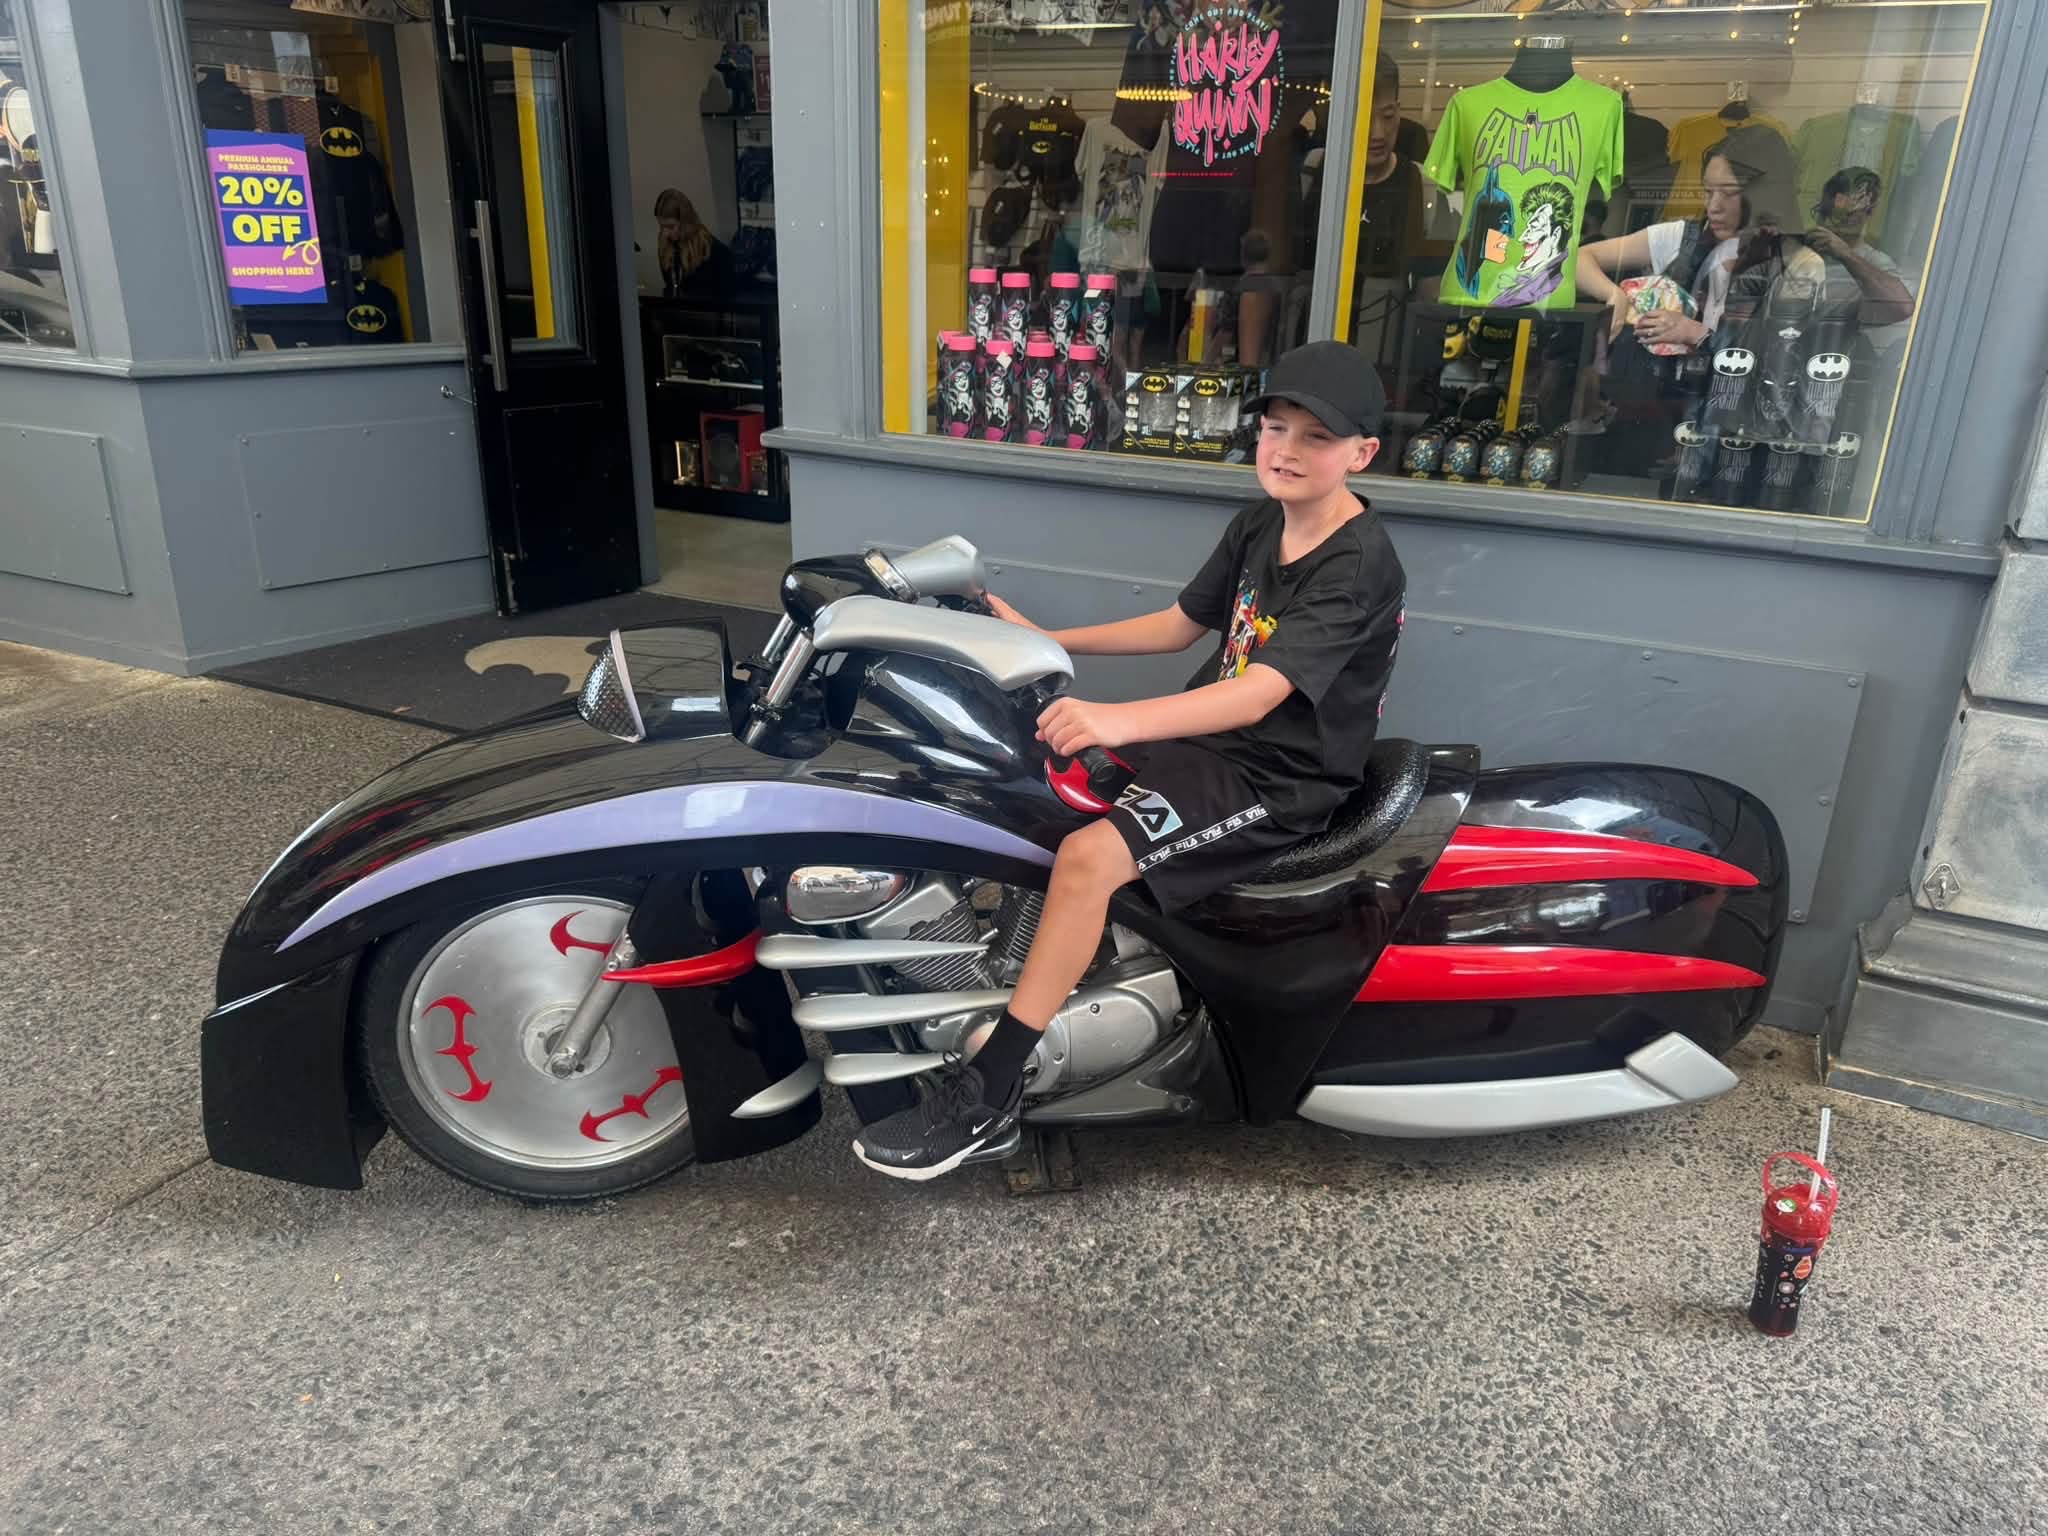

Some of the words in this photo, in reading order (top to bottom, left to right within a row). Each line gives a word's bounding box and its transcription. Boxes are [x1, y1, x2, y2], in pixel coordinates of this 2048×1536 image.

[1177, 23, 1280, 96] HARLEY
[1174, 79, 1272, 167] QUINN
[218, 153, 259, 164] PREMIUM
[261, 156, 295, 165] ANNUAL
[1471, 107, 1582, 186] BATMAN
[227, 163, 288, 173] PASSHOLDERS
[218, 175, 304, 206] 20%
[232, 213, 302, 243] OFF
[231, 266, 284, 277] SHOPPING
[286, 267, 315, 277] HERE!
[1175, 837, 1199, 851] FILA
[1202, 826, 1224, 841] FILA
